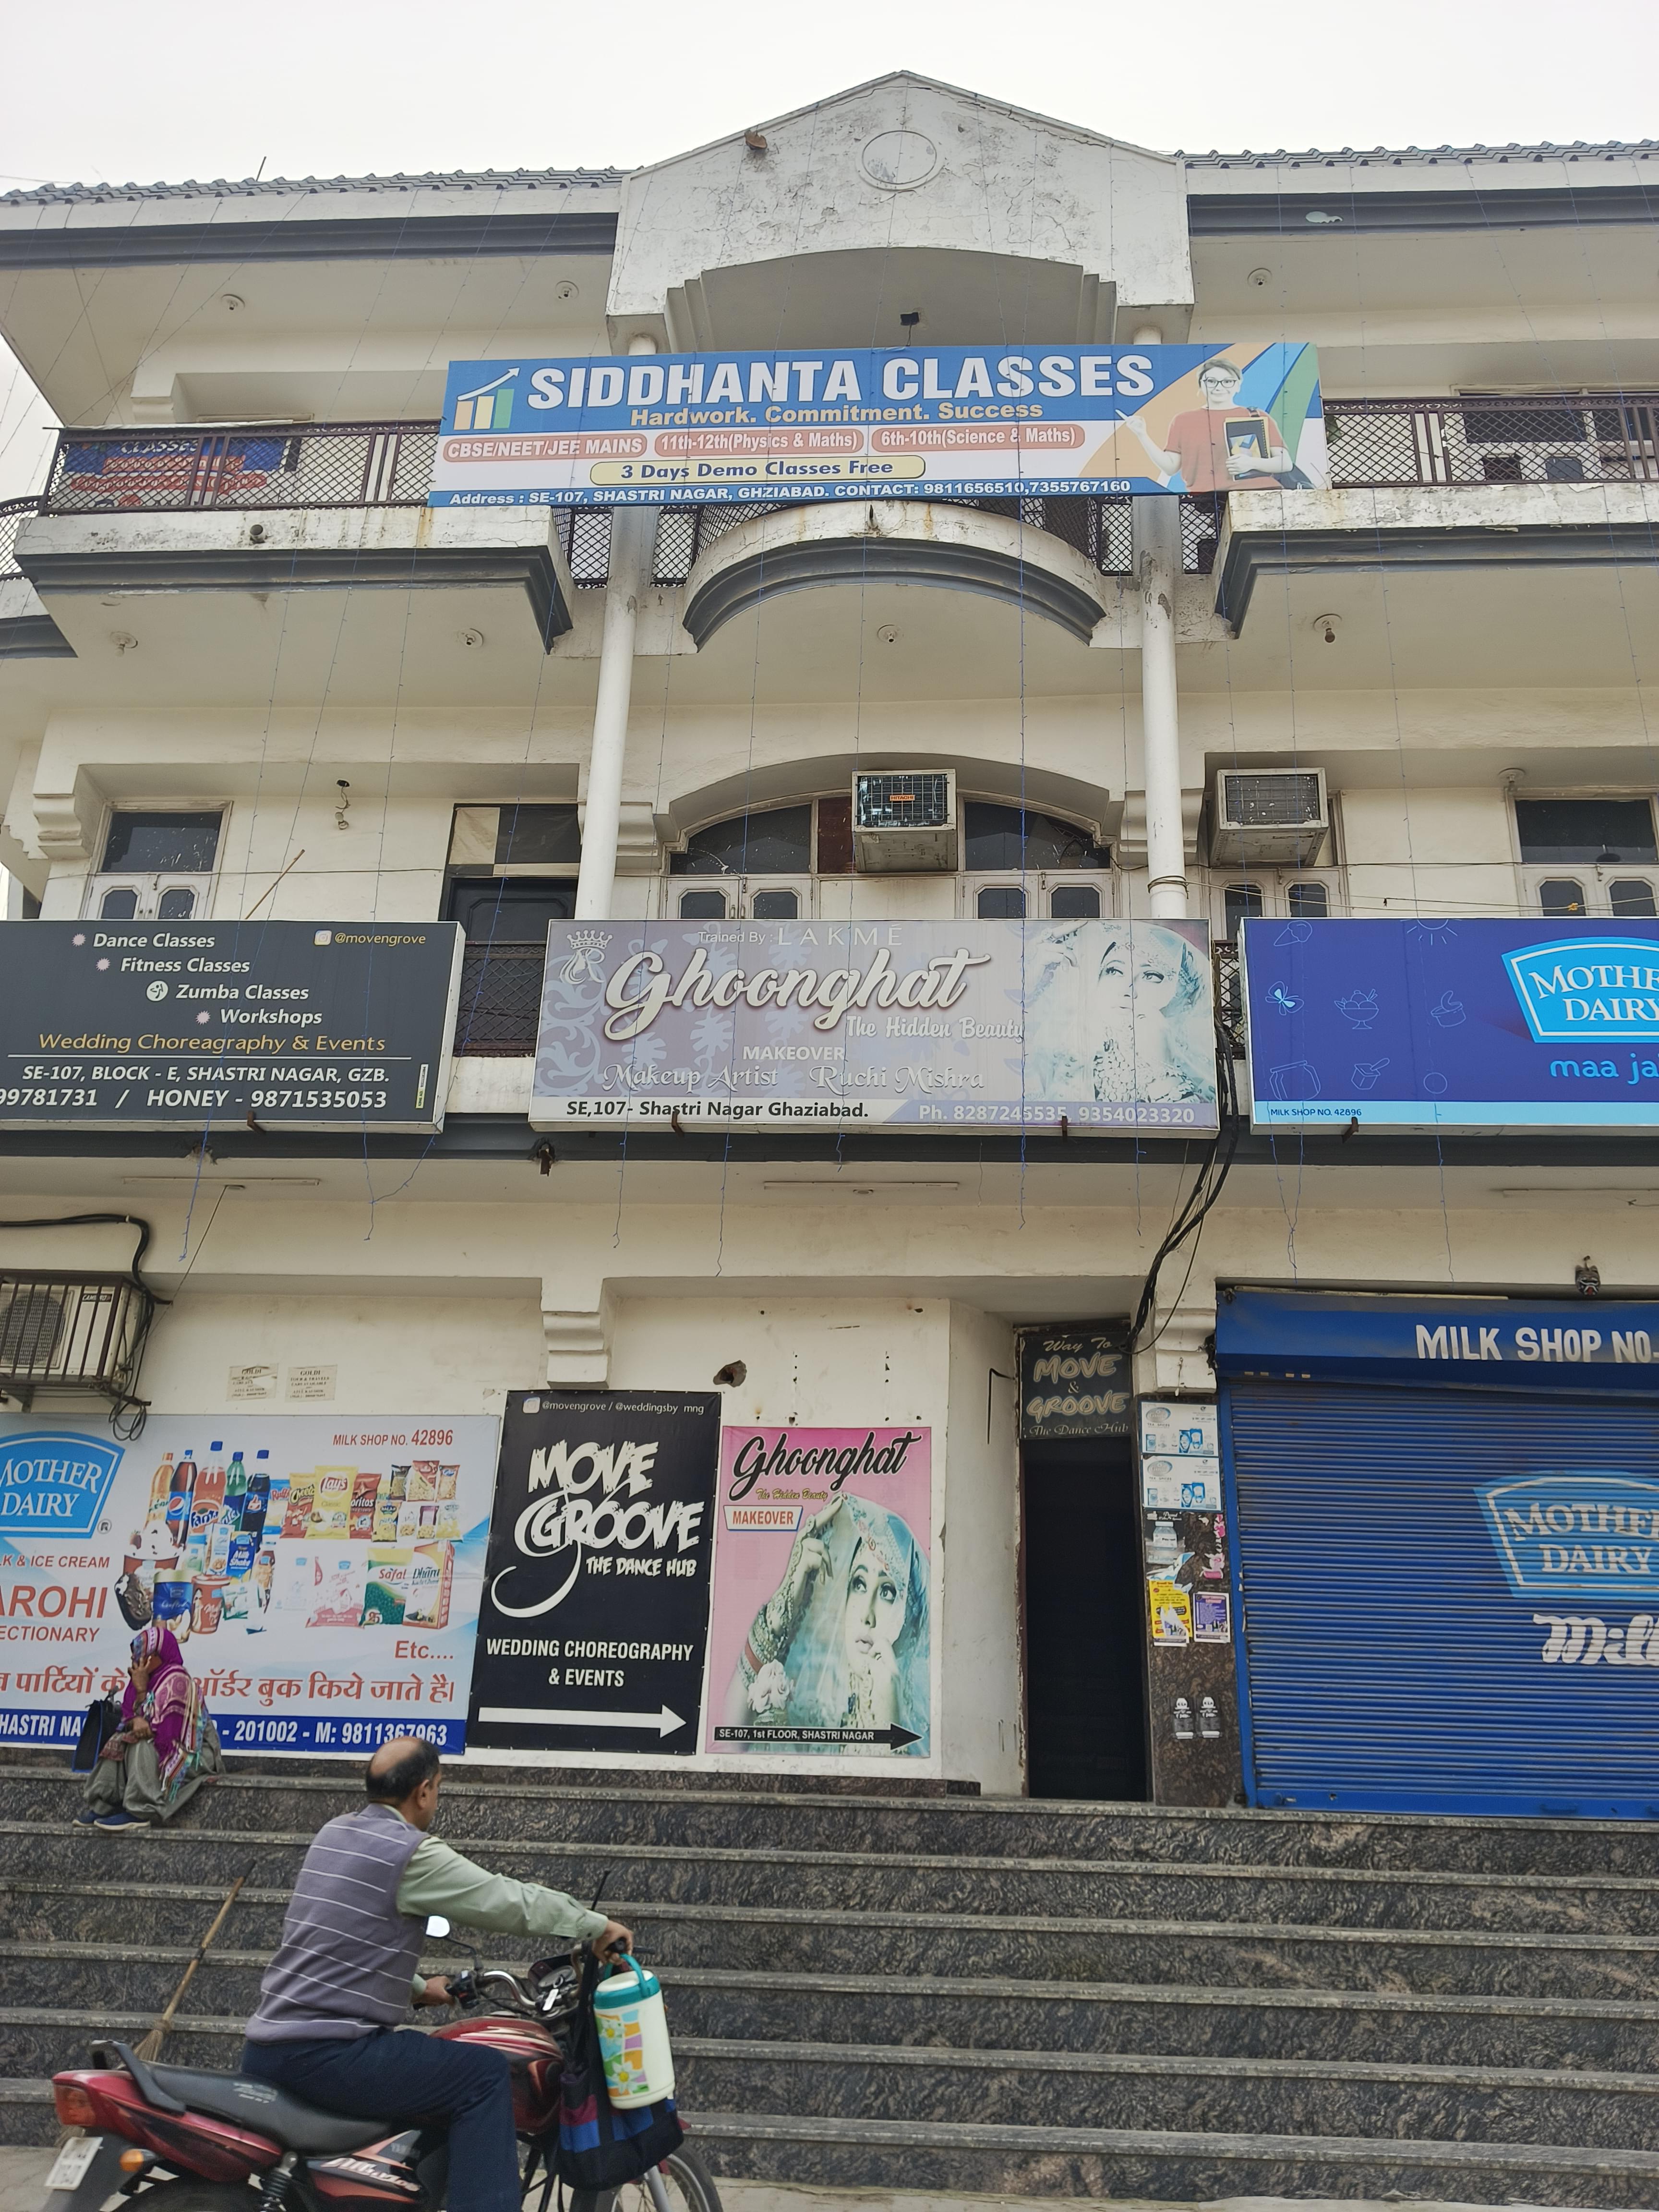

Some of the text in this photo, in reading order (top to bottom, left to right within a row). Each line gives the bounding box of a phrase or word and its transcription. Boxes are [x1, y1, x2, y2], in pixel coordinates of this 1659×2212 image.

[527, 355, 1154, 410] SIDDHANTA CLASSES
[631, 402, 1043, 426] Hardwork. Commitment. Success
[661, 431, 857, 451] 11th-12th(Physics & Maths)
[881, 426, 1076, 447] 6th-10th(Science & Maths)
[447, 438, 643, 458] CBSE/NEET/JEE MAINS
[620, 460, 893, 480] 3 Days Demo Classes Free
[449, 480, 1130, 505] Address SE-107, SHASTRI NAGAR, GHZIABAD. CONTACT: 9811656510,7355767160
[93, 933, 215, 949] Dance Classes
[335, 932, 426, 947] @movengrove
[698, 931, 745, 943] Trained
[749, 932, 766, 945] By
[120, 958, 250, 973] Fitness Classes
[176, 984, 309, 1000] Zumba Classes
[604, 948, 990, 1040] Ghoonghat
[220, 1009, 323, 1026] Workshops
[1563, 998, 1659, 1021] DAIRY
[847, 1015, 1023, 1043] The Hidden Beauty
[39, 1033, 385, 1055] Wedding Choreagraphy & Events
[743, 1046, 845, 1060] MAKEOVER
[23, 1065, 390, 1084] SE-107, BLOCK E, SHASTRI NAGAR, GZB.
[1550, 1053, 1659, 1084] maa ja
[602, 1065, 984, 1095] Makeup Artist Ruchi Mishra
[0, 1088, 97, 1107] 99781731
[147, 1089, 229, 1107] HONEY
[250, 1090, 387, 1108] 9871535053
[566, 1101, 869, 1119] SE,107- Shastri Nagar Ghaziabad.
[919, 1106, 947, 1120] Ph.
[1079, 1107, 1195, 1123] 9354023320
[1043, 1337, 1113, 1353] Way To
[1416, 1325, 1503, 1360] MILK
[1515, 1328, 1601, 1362] SHOP
[1034, 1351, 1122, 1383] MOVE
[1068, 1381, 1080, 1393] &
[542, 1401, 606, 1412] @movengrove
[1026, 1390, 1130, 1423] GROOVE
[333, 1430, 453, 1445] MILK SHOP NO. 42896
[1030, 1421, 1128, 1435] The Dance Hub
[528, 1439, 659, 1498] MOVE
[729, 1431, 922, 1501] Ghoonghat
[1, 1492, 80, 1517] DAIRY
[351, 1498, 374, 1507] oritos
[756, 1489, 828, 1501] The Hidden Beauty
[514, 1495, 705, 1557] GROOVE
[733, 1511, 793, 1525] MAKEOVER
[1504, 1503, 1659, 1542] MOTHE
[17, 1555, 109, 1568] & ICE CREAM
[586, 1556, 697, 1577] THE DANCE HUB
[1539, 1544, 1652, 1574] DAIRY
[0, 1586, 108, 1618] ROHI
[487, 1638, 694, 1662] WEDDING CHOREOGRAPHY
[16, 1665, 95, 1694] पार्टियों
[258, 1679, 302, 1706] बुक
[309, 1671, 364, 1699] किये
[372, 1673, 423, 1701] जाते
[548, 1669, 625, 1687] & EVENTS
[0, 1714, 56, 1736] HASTRI
[234, 1720, 296, 1743] 201002
[315, 1722, 336, 1743] M:
[719, 1729, 874, 1740] SE-107, 1st FLOOR, SHASTRI NAGAR
